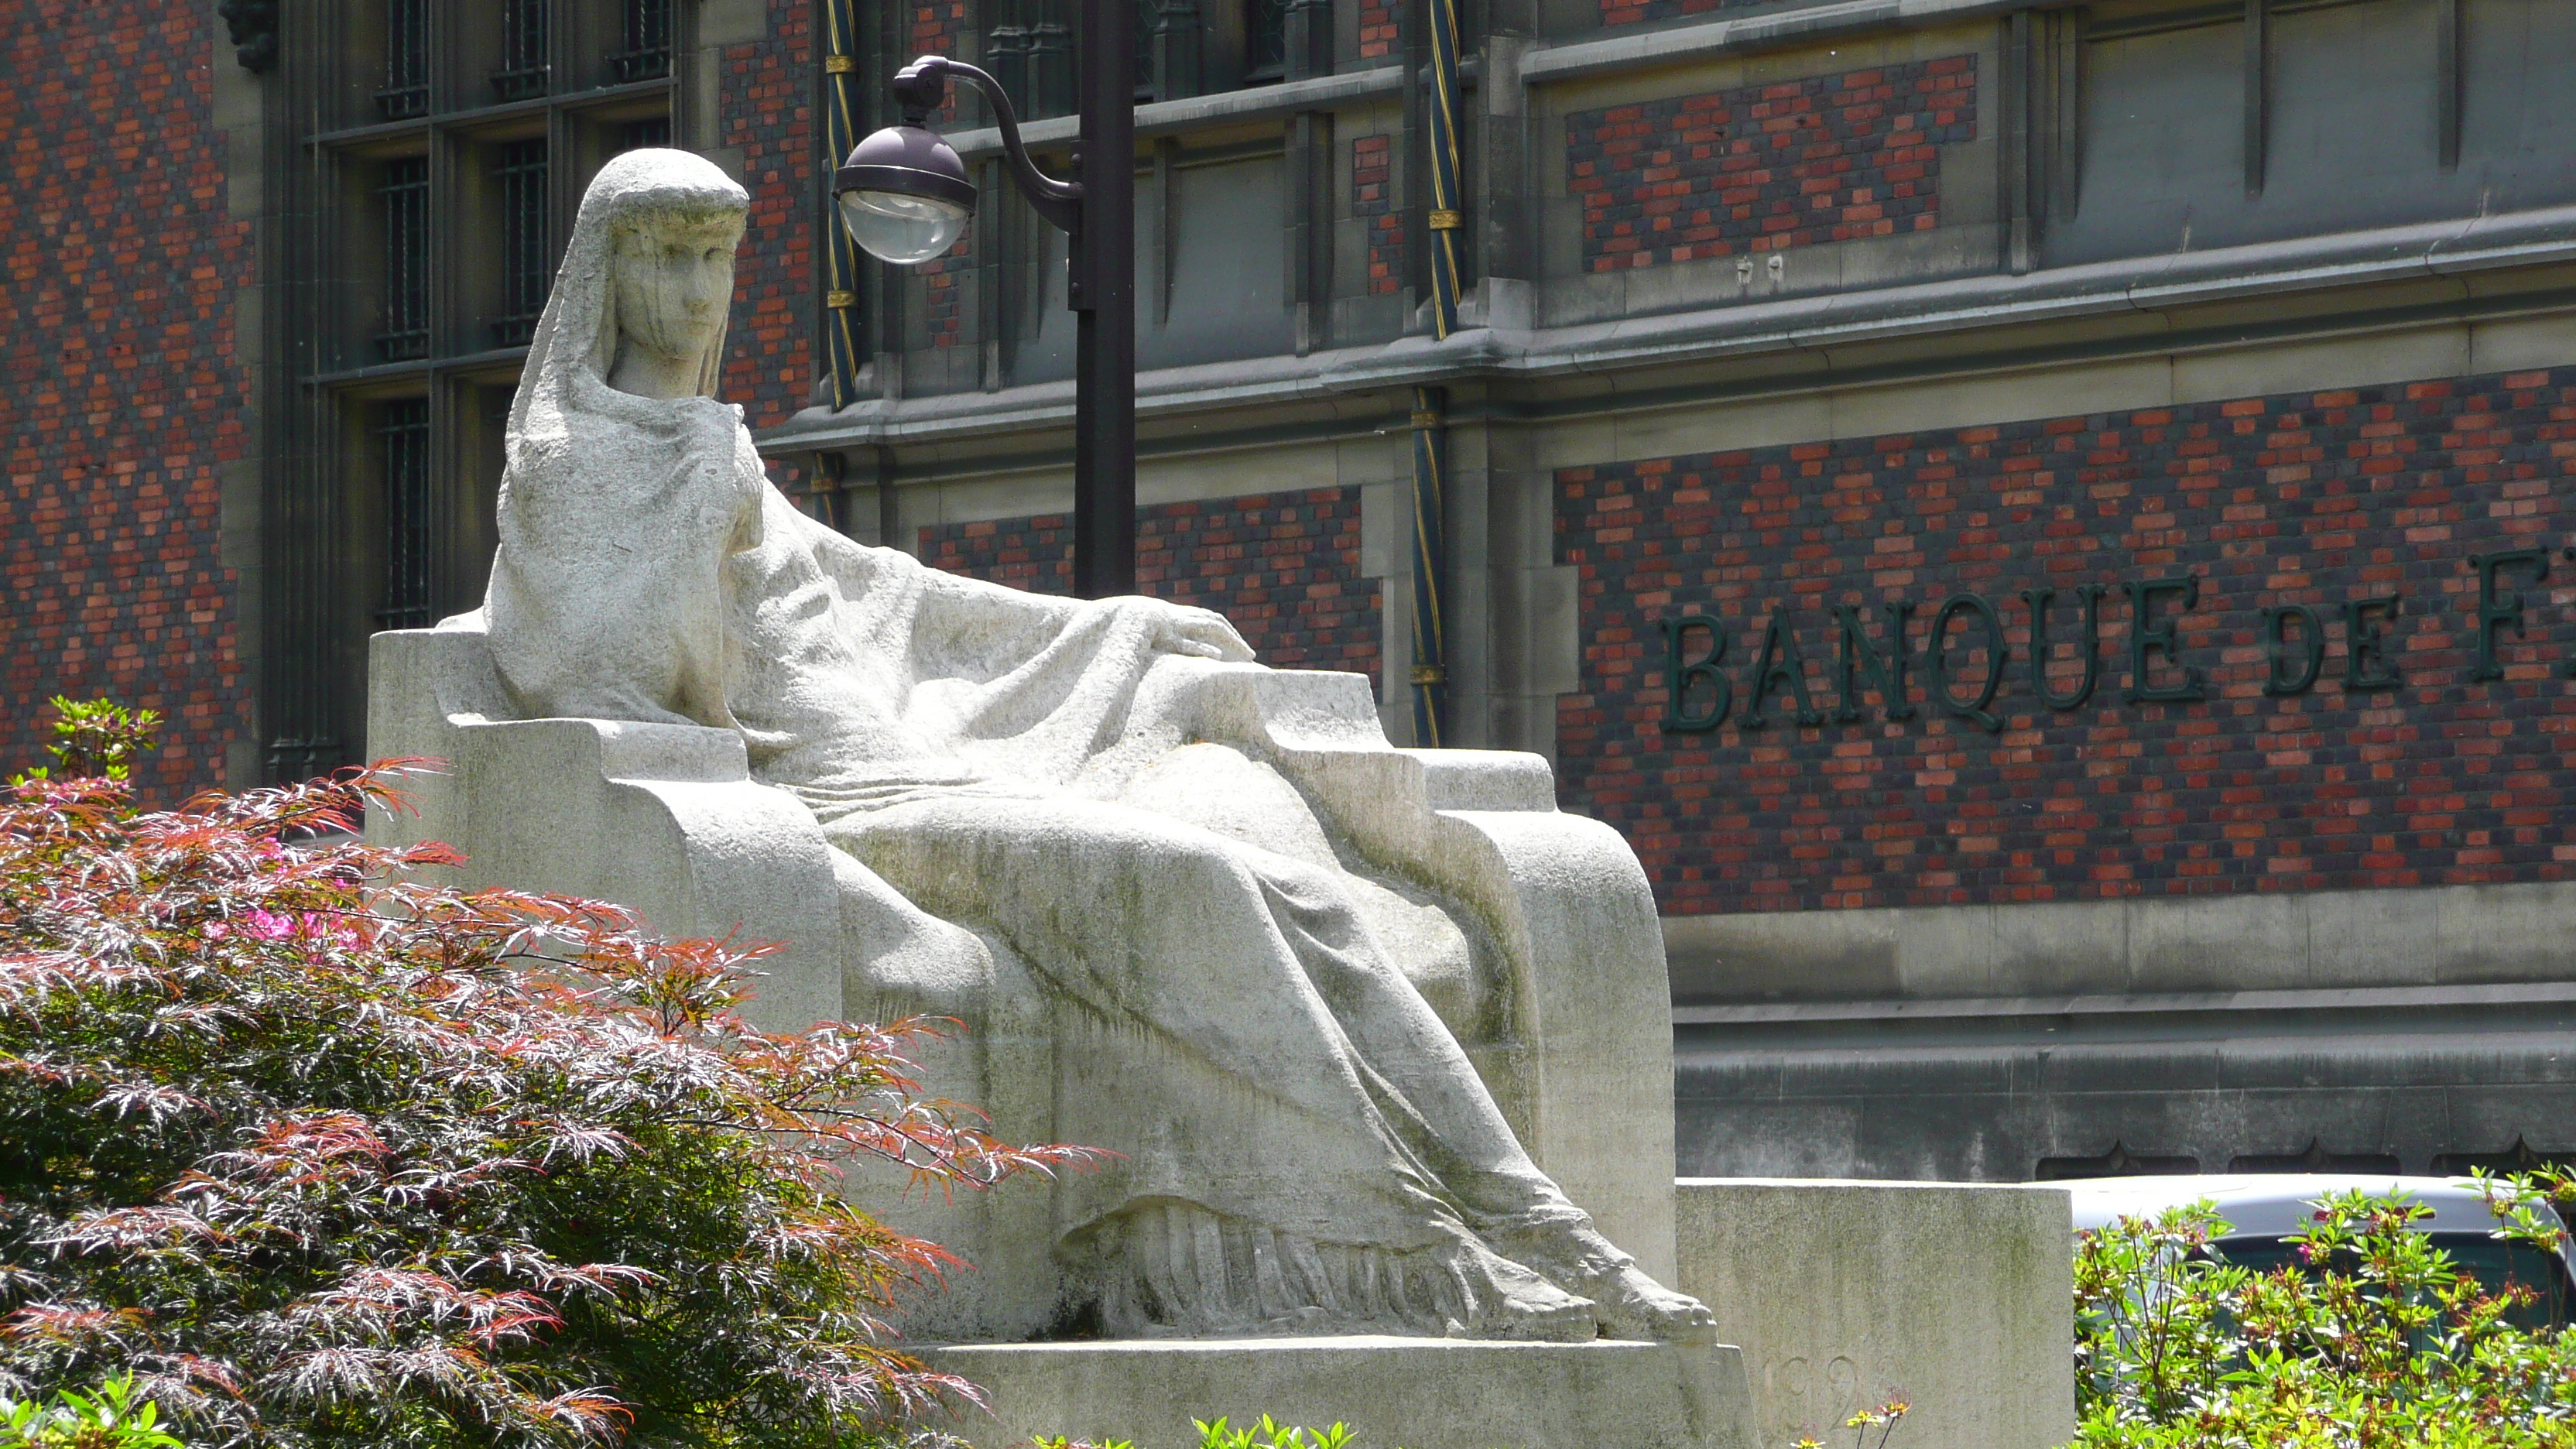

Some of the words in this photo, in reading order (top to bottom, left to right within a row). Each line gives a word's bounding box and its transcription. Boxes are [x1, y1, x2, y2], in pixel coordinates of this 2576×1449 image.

[1659, 574, 2204, 732] BANQUE
[2261, 591, 2403, 697] DE
[2467, 545, 2576, 683] F
